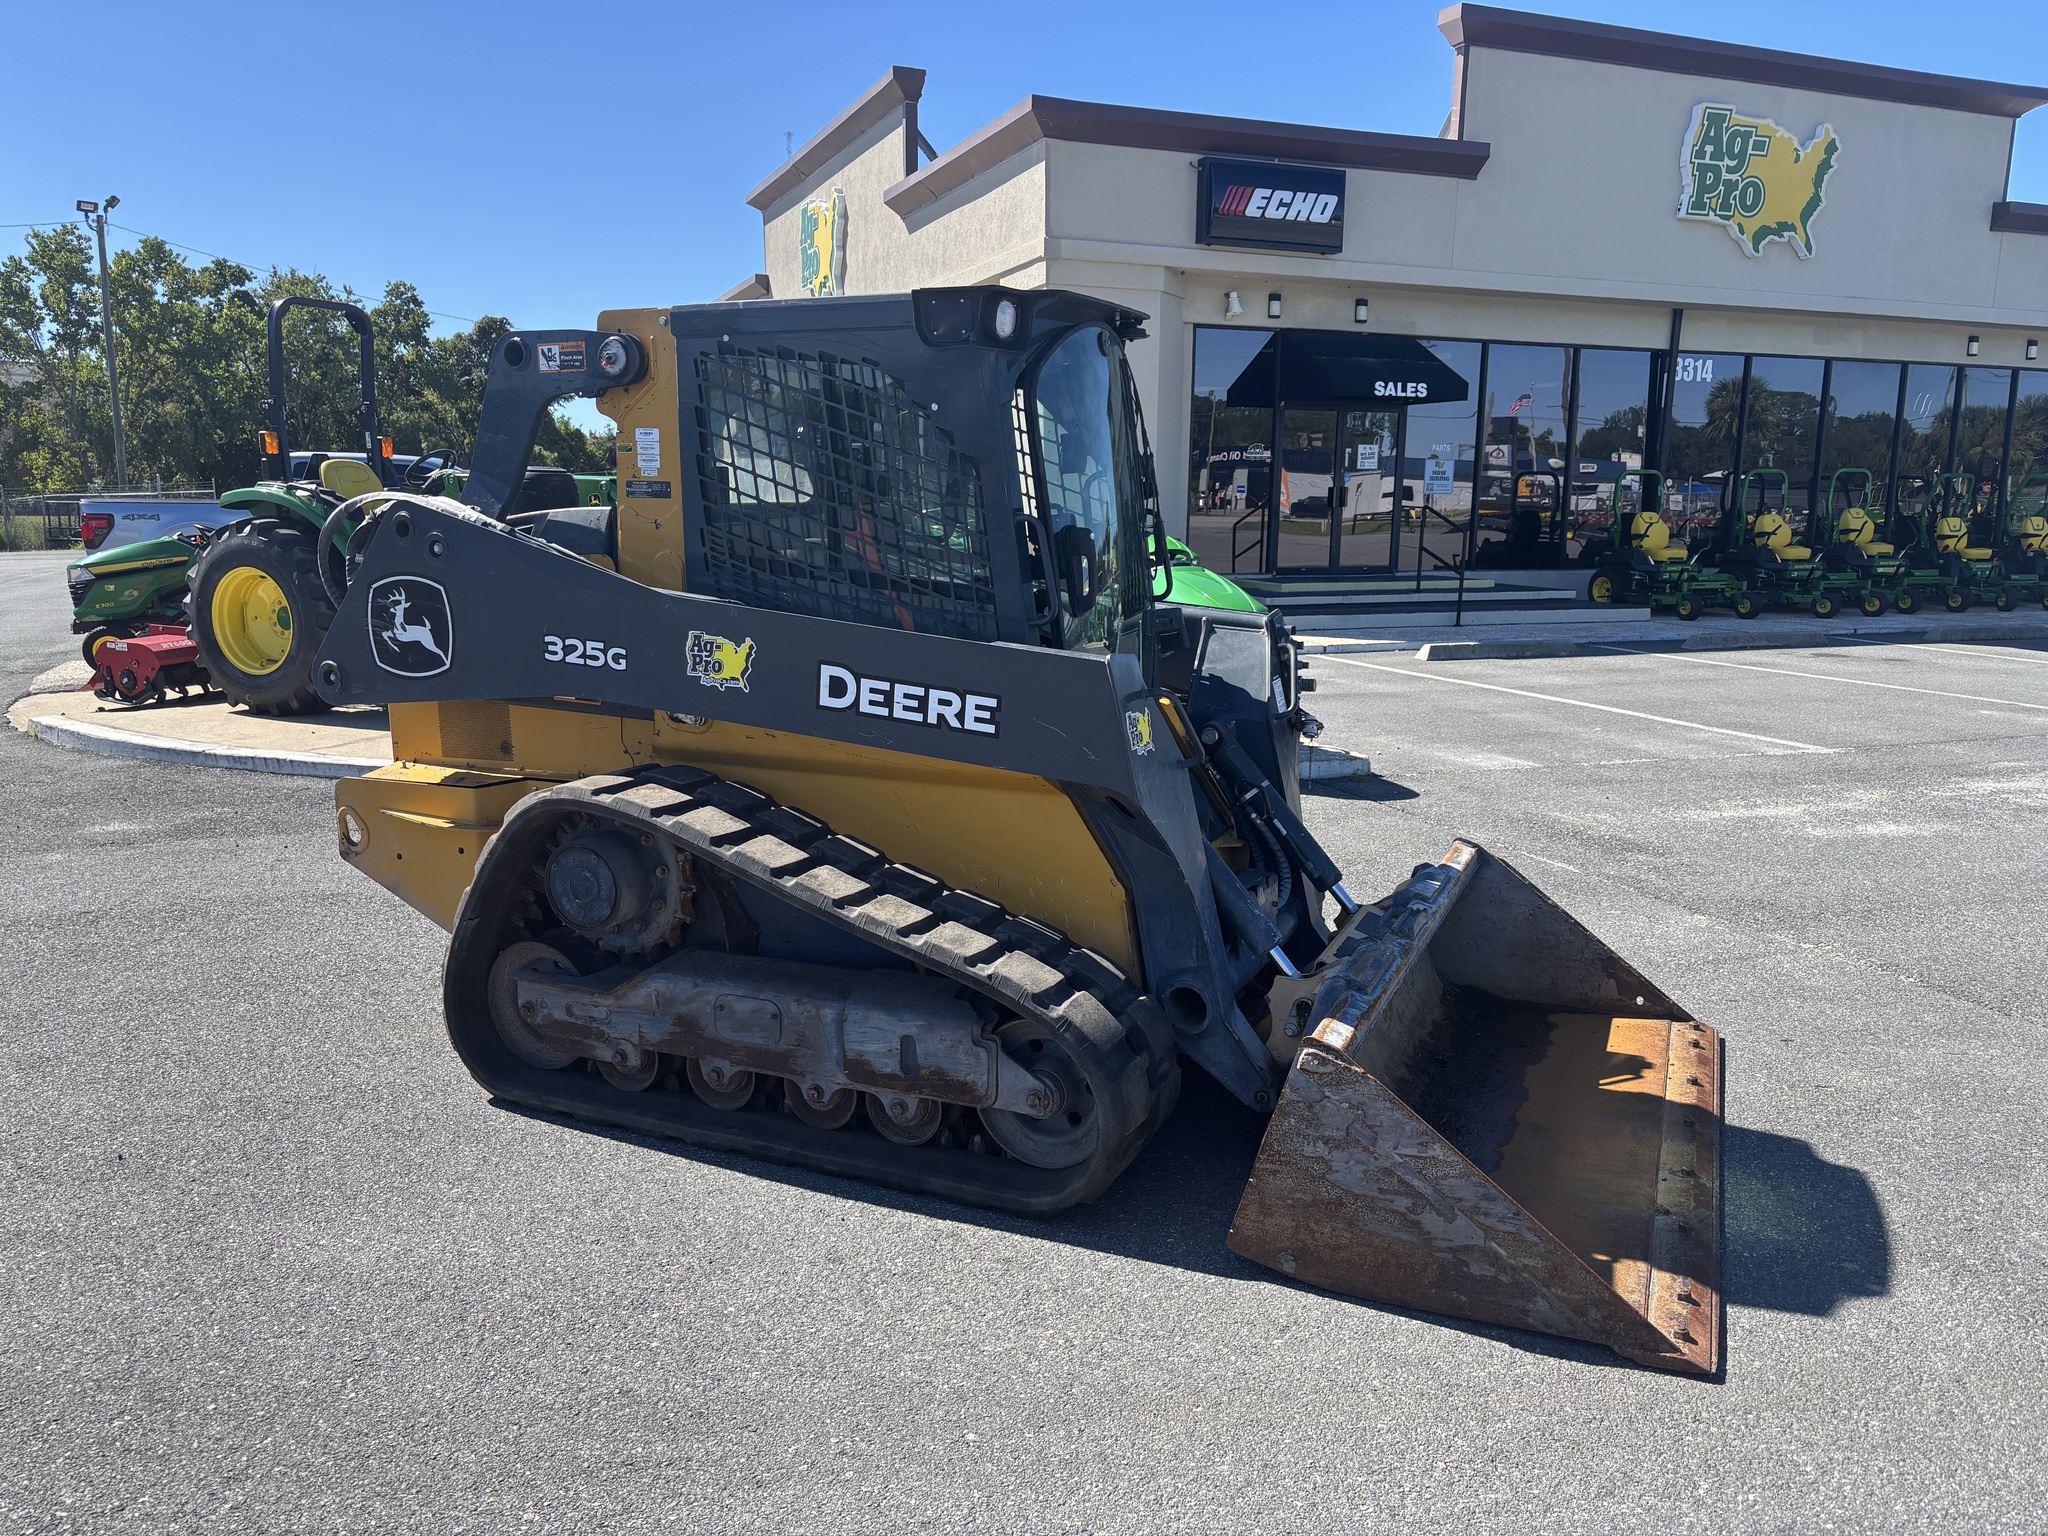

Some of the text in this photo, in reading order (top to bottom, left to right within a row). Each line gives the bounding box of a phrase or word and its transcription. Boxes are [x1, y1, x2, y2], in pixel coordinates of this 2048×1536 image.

[1691, 108, 1770, 175] Ag-
[1245, 187, 1339, 224] ECHO
[1688, 163, 1765, 217] Pro
[1374, 381, 1428, 398] SALES
[1431, 444, 1451, 452] PARTS
[544, 635, 627, 671] 325G
[689, 633, 723, 659] Ag-
[689, 653, 724, 675] Pro
[819, 664, 998, 734] DEERE
